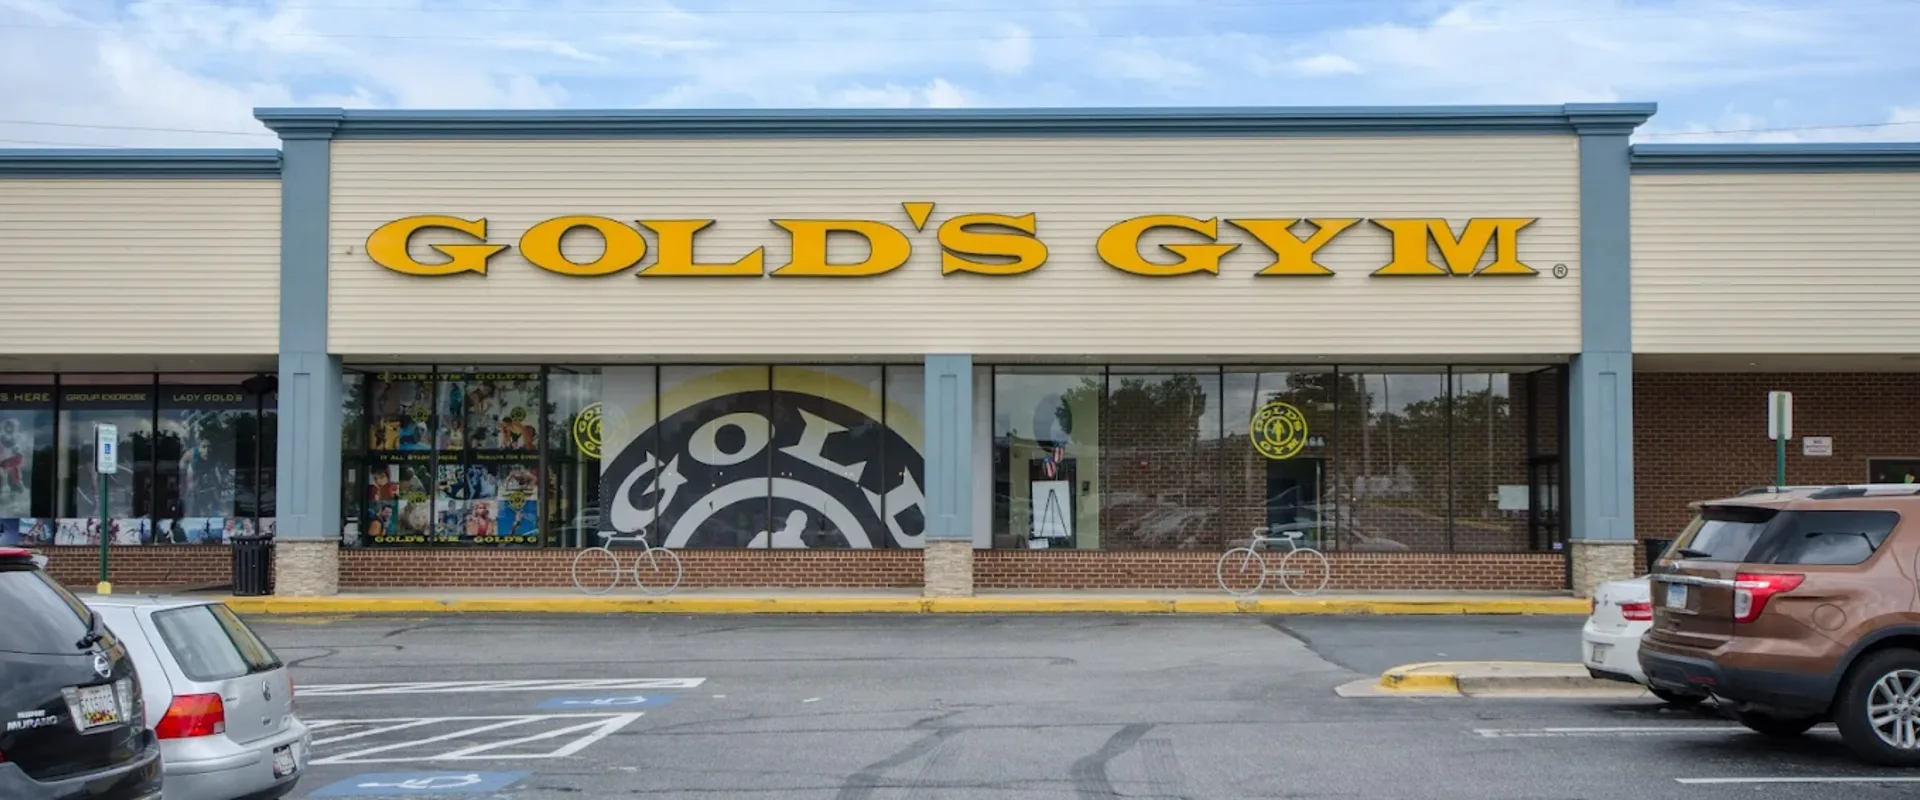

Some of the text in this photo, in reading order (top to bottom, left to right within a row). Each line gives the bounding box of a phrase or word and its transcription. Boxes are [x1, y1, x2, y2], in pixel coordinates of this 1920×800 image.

[365, 201, 1049, 277] GOLD'S
[1096, 214, 1540, 278] GYM
[14, 392, 51, 402] HERE
[65, 393, 100, 402] GROUP
[173, 394, 200, 402] LADY
[1255, 407, 1302, 431] GOLD'S
[1260, 439, 1299, 455] GYM
[374, 535, 425, 543] GOLD'S
[473, 535, 524, 543] GOLD'S
[7, 715, 58, 730] MURANO
